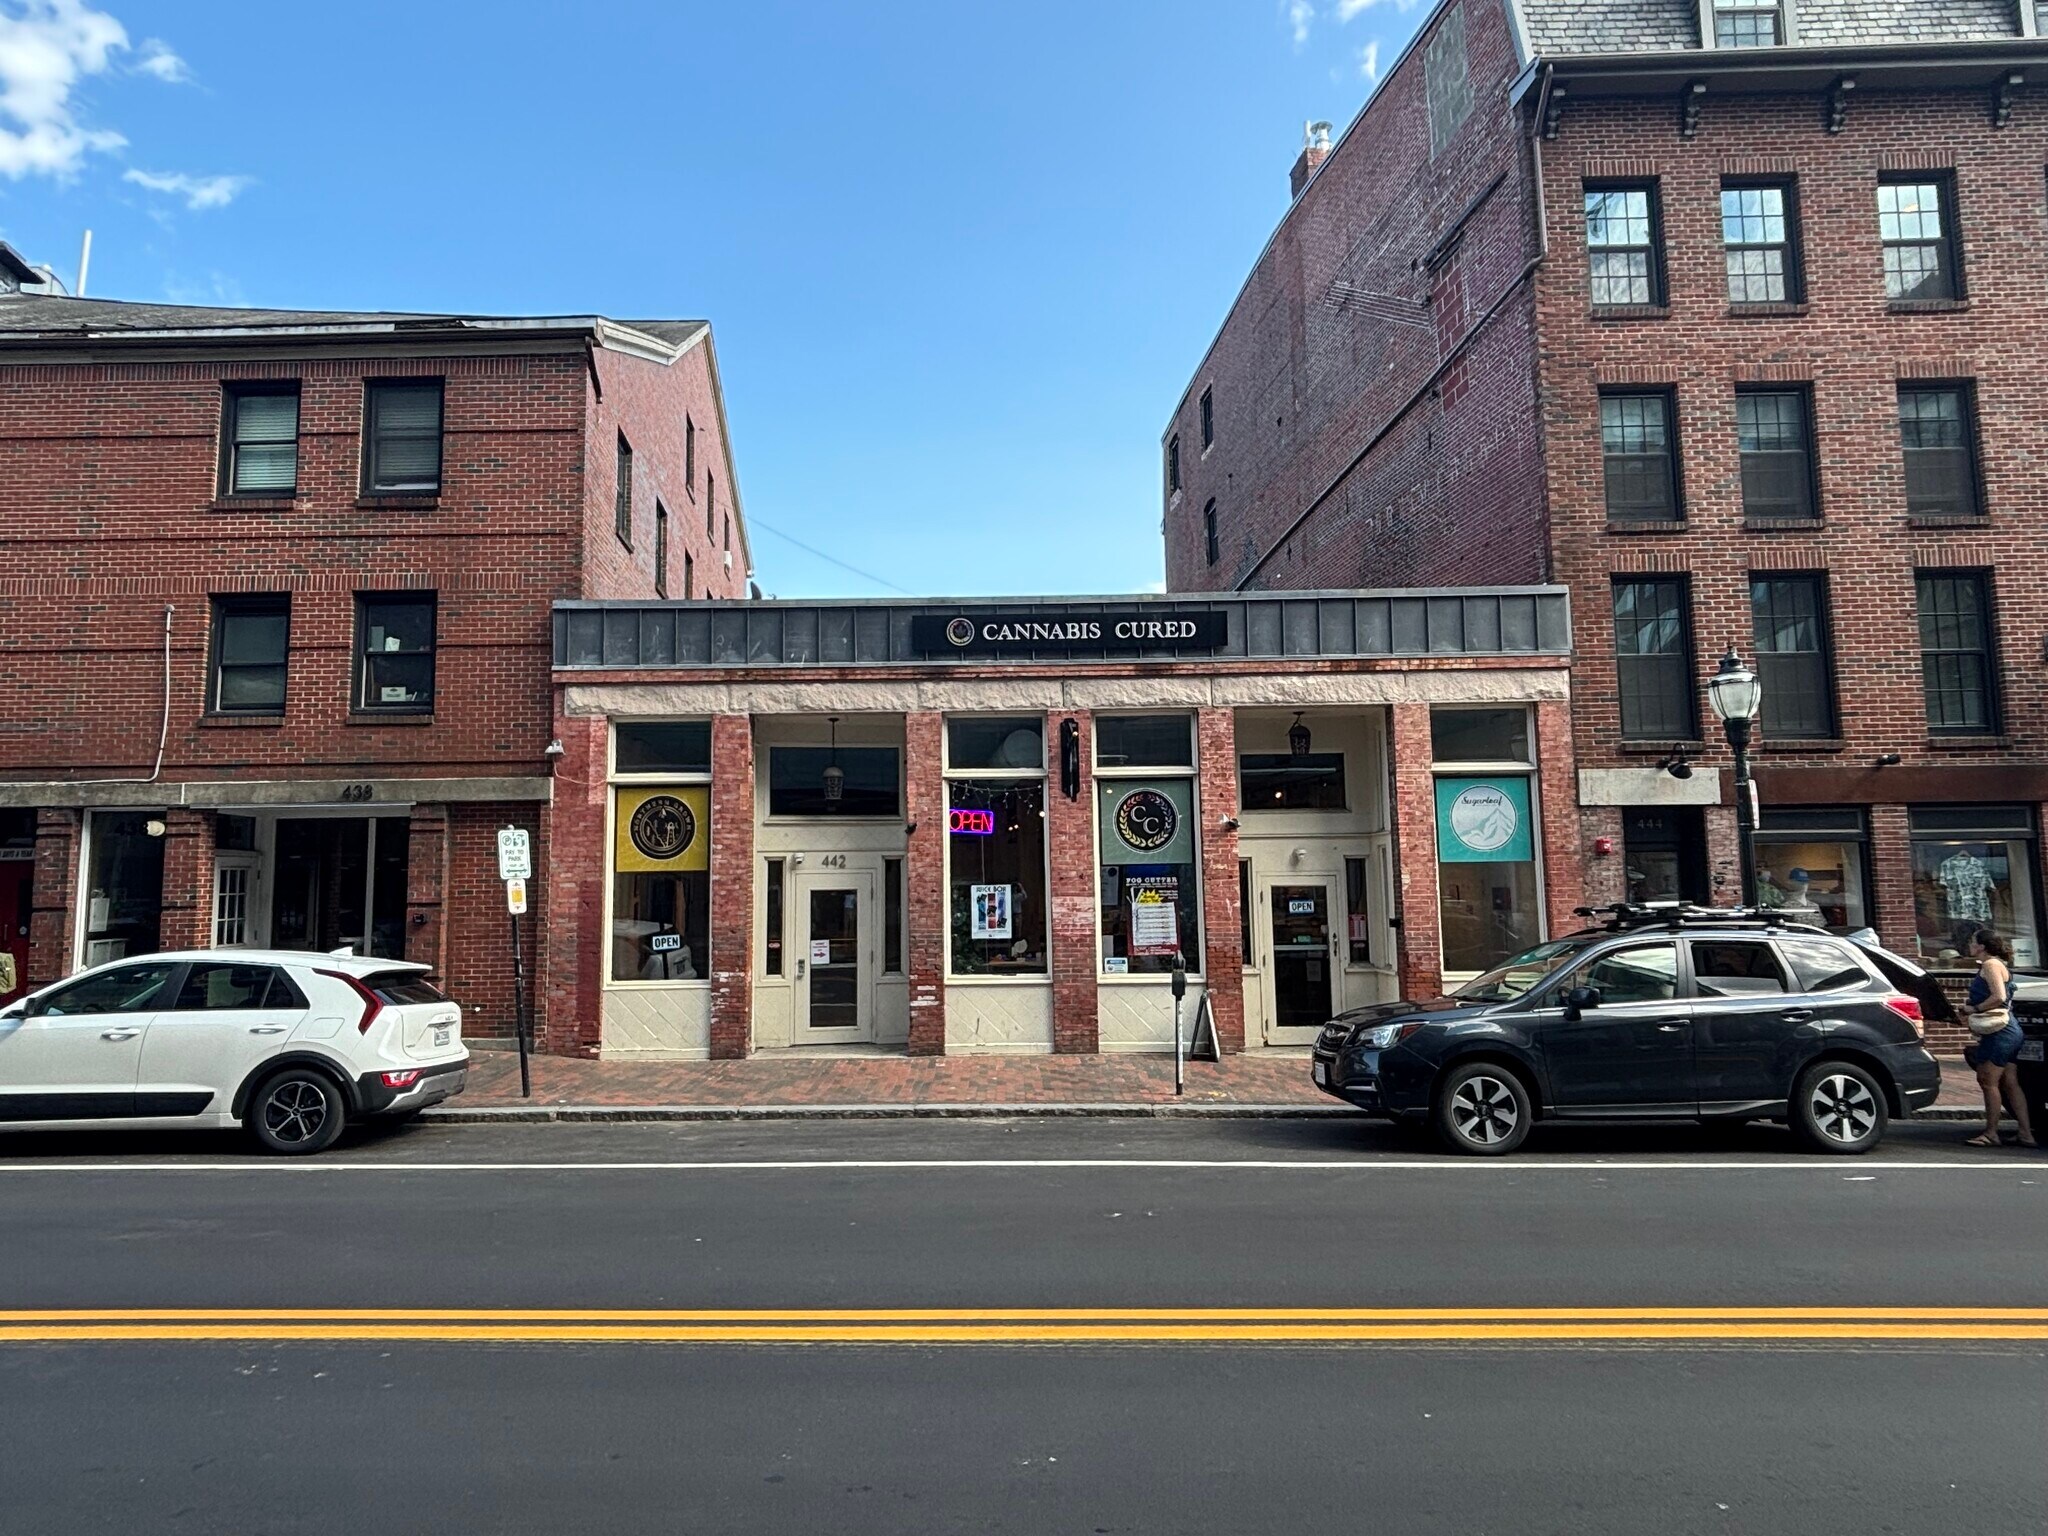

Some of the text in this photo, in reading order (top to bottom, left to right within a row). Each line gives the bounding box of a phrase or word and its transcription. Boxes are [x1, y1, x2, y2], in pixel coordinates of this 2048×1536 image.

[982, 620, 1197, 641] CANNABIS CURED
[342, 784, 373, 800] 438
[1461, 796, 1502, 806] Sugarleaf
[633, 799, 692, 831] NORTHERN GROWN
[949, 810, 992, 832] OPEN
[1637, 819, 1663, 829] 444
[821, 854, 847, 869] 442
[1291, 902, 1312, 912] OPEN
[654, 936, 679, 948] OPEN
